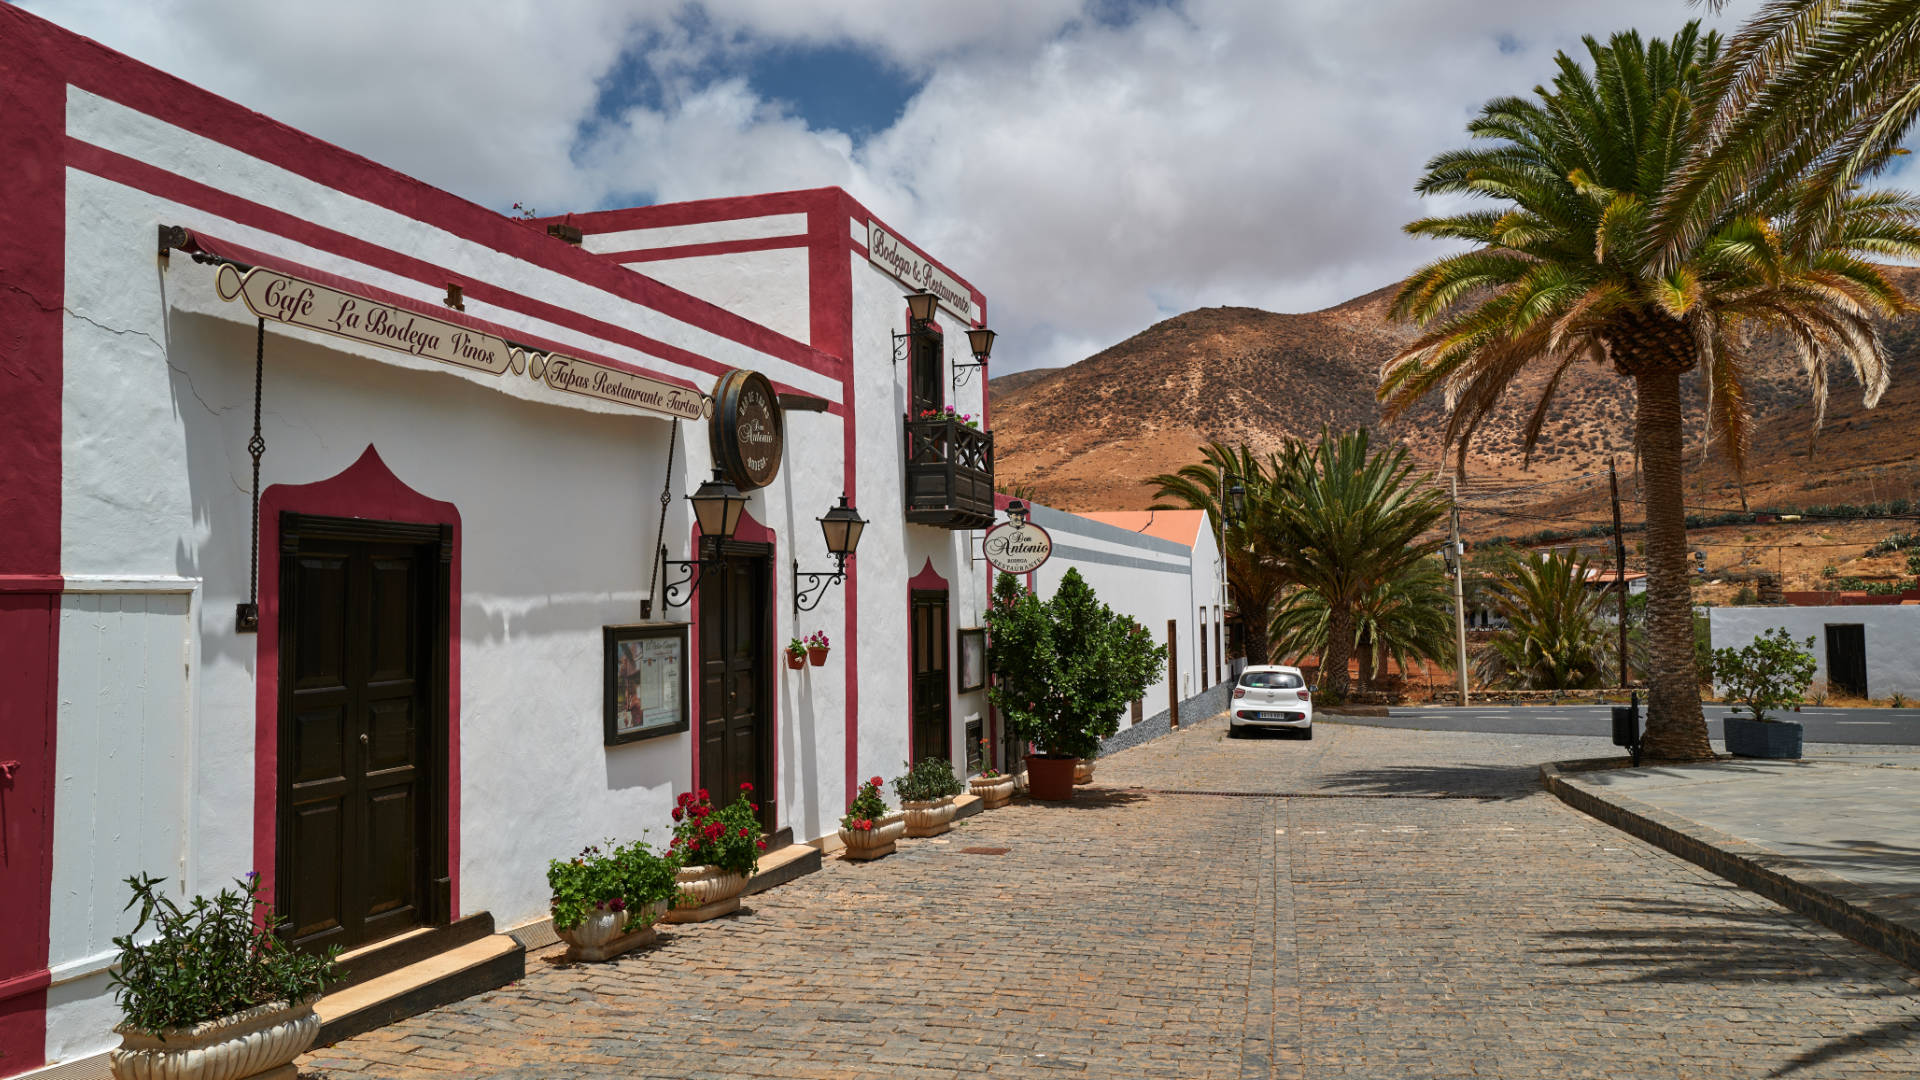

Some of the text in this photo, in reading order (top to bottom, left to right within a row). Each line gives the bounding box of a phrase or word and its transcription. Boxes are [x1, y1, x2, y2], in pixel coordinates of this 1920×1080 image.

[873, 228, 969, 314] Bodega & Restaurante
[265, 279, 495, 364] Café La Bodega Vinos
[551, 361, 700, 415] Tapas Restaurante Tartas
[738, 423, 772, 445] Antonio
[986, 537, 1048, 556] Antonio
[1009, 531, 1032, 543] Don
[992, 557, 1042, 571] RESTAURANTE
